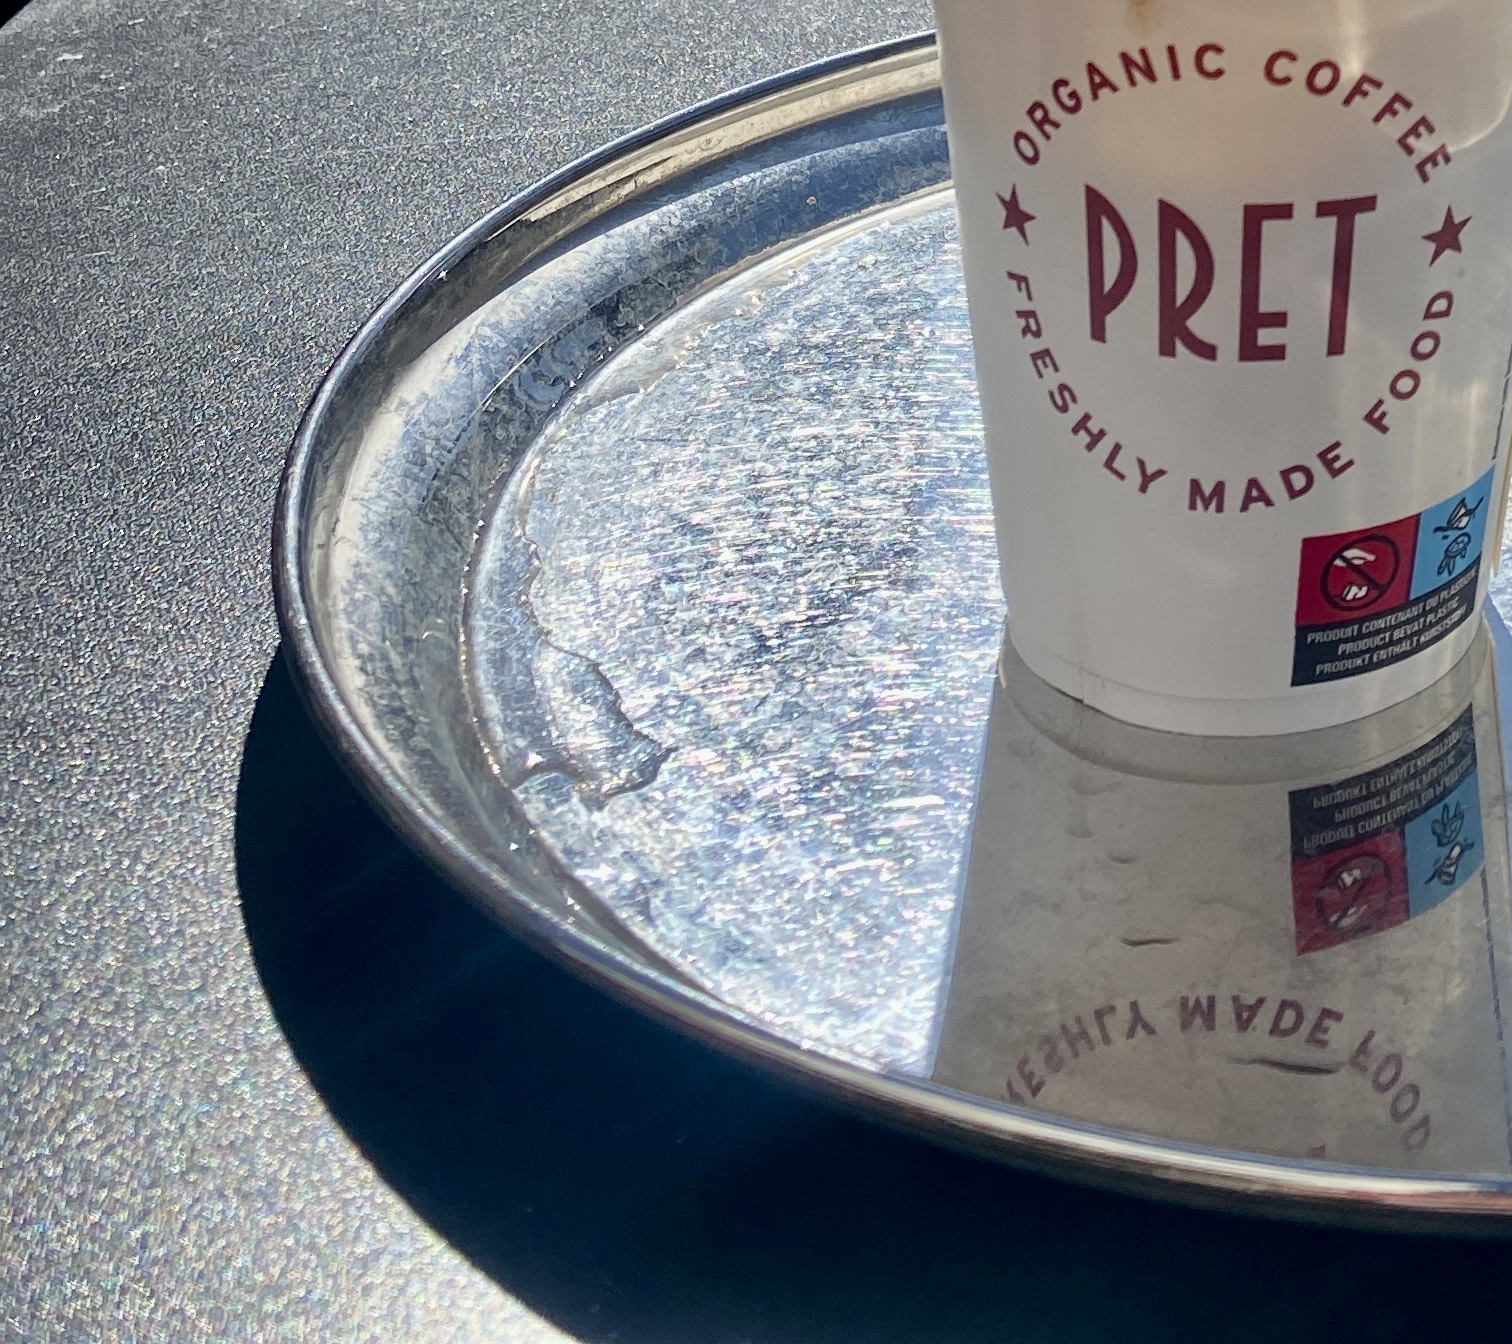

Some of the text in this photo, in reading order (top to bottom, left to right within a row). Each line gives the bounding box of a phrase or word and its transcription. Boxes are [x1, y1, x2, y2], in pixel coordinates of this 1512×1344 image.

[1012, 41, 1453, 184] ORGANIC COFFEE
[1084, 183, 1378, 363] PRET
[1006, 270, 1455, 514] FRESHLY MADE FOOD
[1306, 624, 1359, 645] PRODUIT
[1315, 653, 1371, 676] PRODUKT
[1337, 632, 1391, 656] PRODUCT
